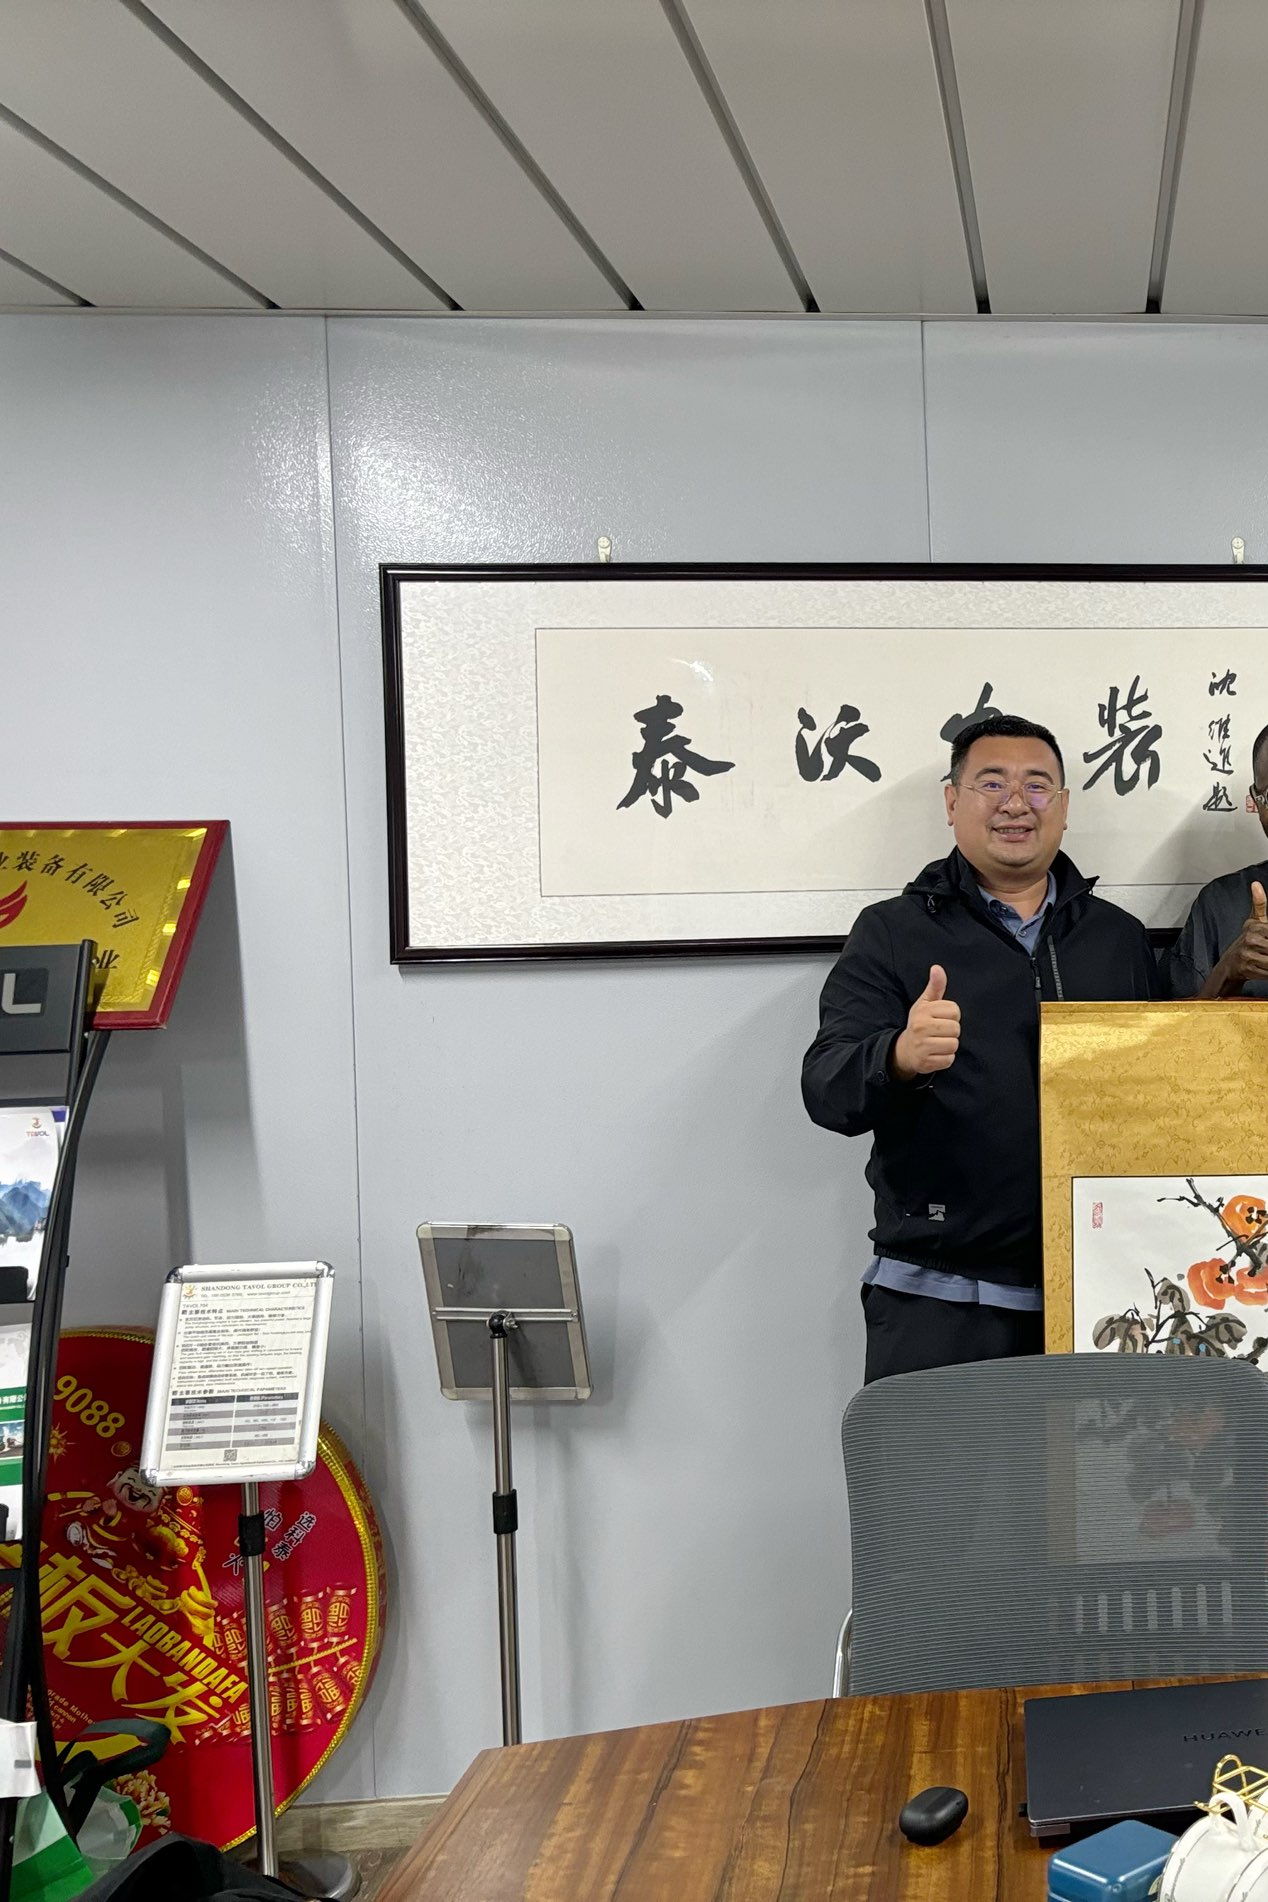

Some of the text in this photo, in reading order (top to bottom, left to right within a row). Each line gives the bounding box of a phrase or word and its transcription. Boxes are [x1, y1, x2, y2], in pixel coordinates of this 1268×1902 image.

[617, 675, 1162, 818] 泰沃装
[0, 850, 139, 929] 装备有限公司
[53, 1375, 125, 1438] 9088
[121, 1606, 248, 1704] LAOBANDAFA
